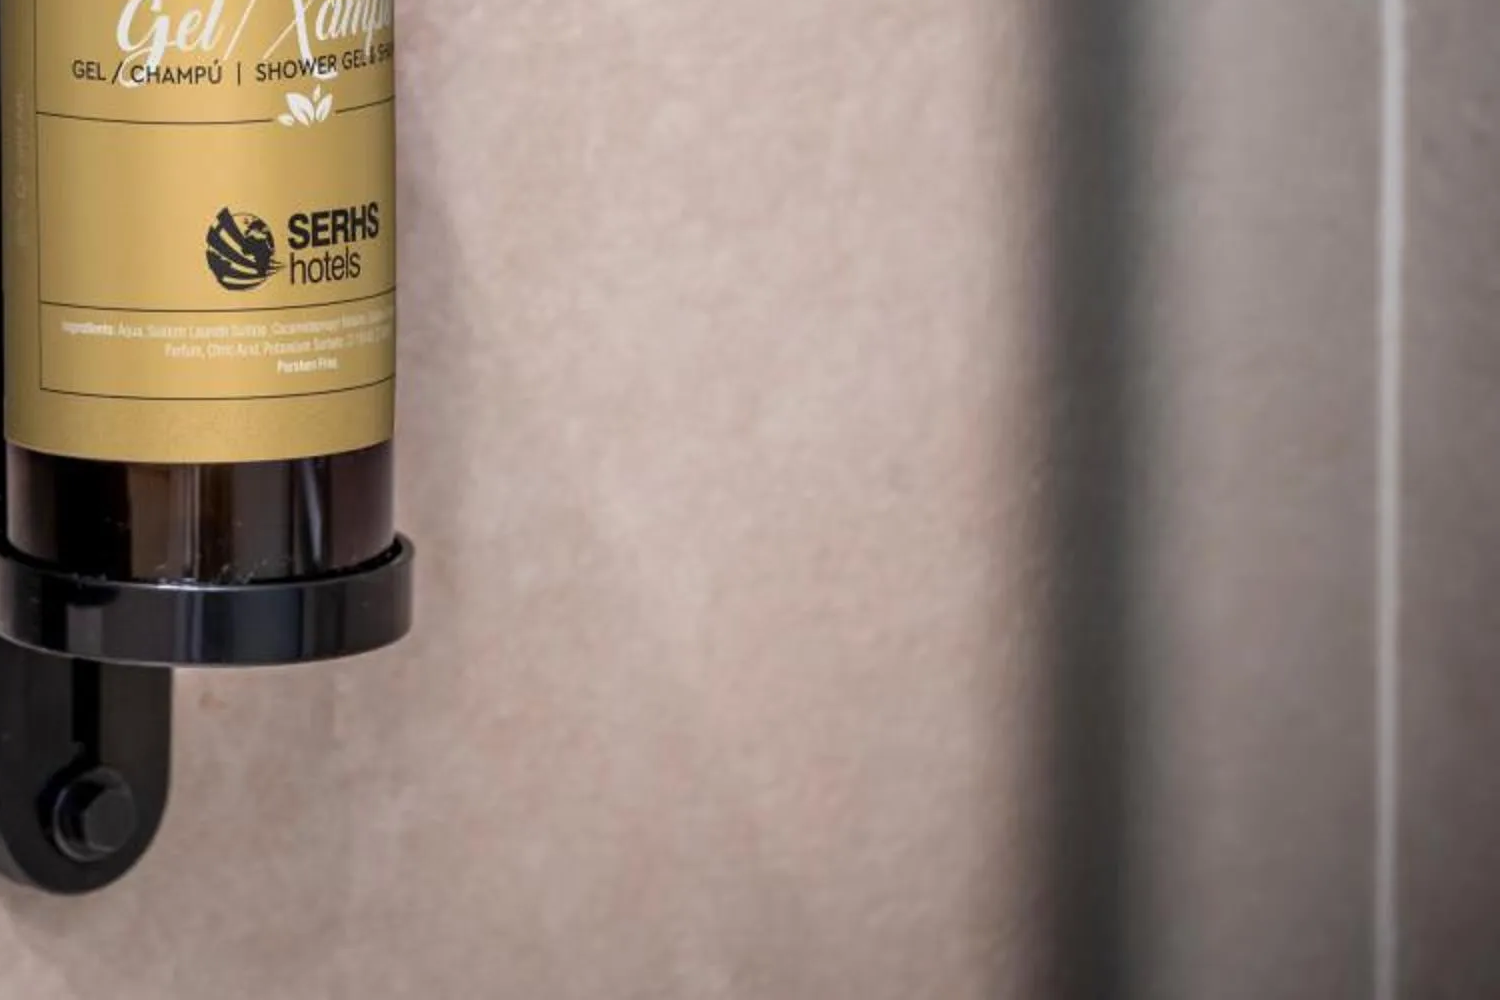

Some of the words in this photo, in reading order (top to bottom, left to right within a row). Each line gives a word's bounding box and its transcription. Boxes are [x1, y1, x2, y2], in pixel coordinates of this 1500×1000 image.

[71, 60, 106, 82] GEL
[130, 60, 223, 84] CHAMPÚ
[256, 55, 337, 82] SHOWER
[287, 201, 380, 250] SERHS
[288, 246, 361, 285] hotels
